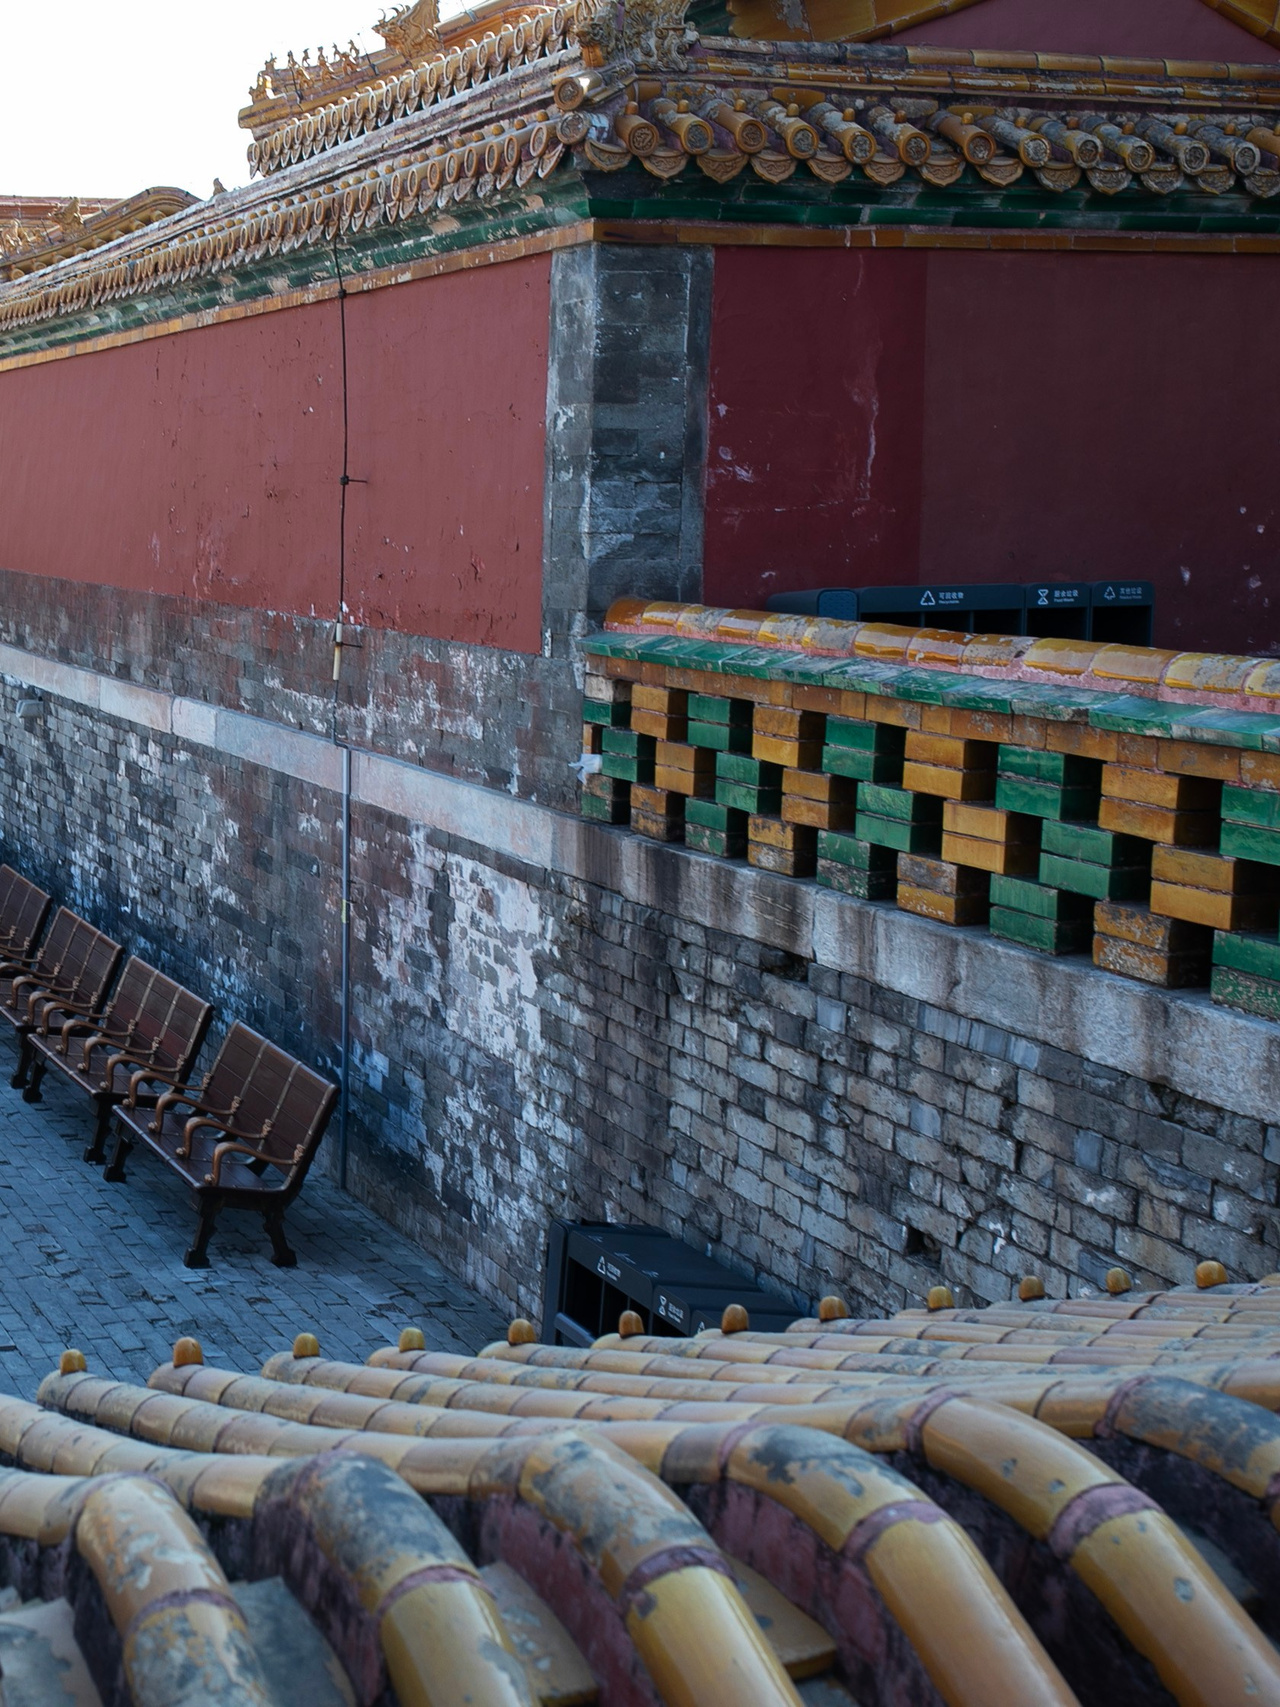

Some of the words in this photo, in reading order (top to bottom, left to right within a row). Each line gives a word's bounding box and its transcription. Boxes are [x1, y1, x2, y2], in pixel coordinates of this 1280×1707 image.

[938, 591, 964, 600] 可回收物
[1054, 589, 1079, 598] 厨余垃圾
[1119, 587, 1142, 595] 其他垃圾
